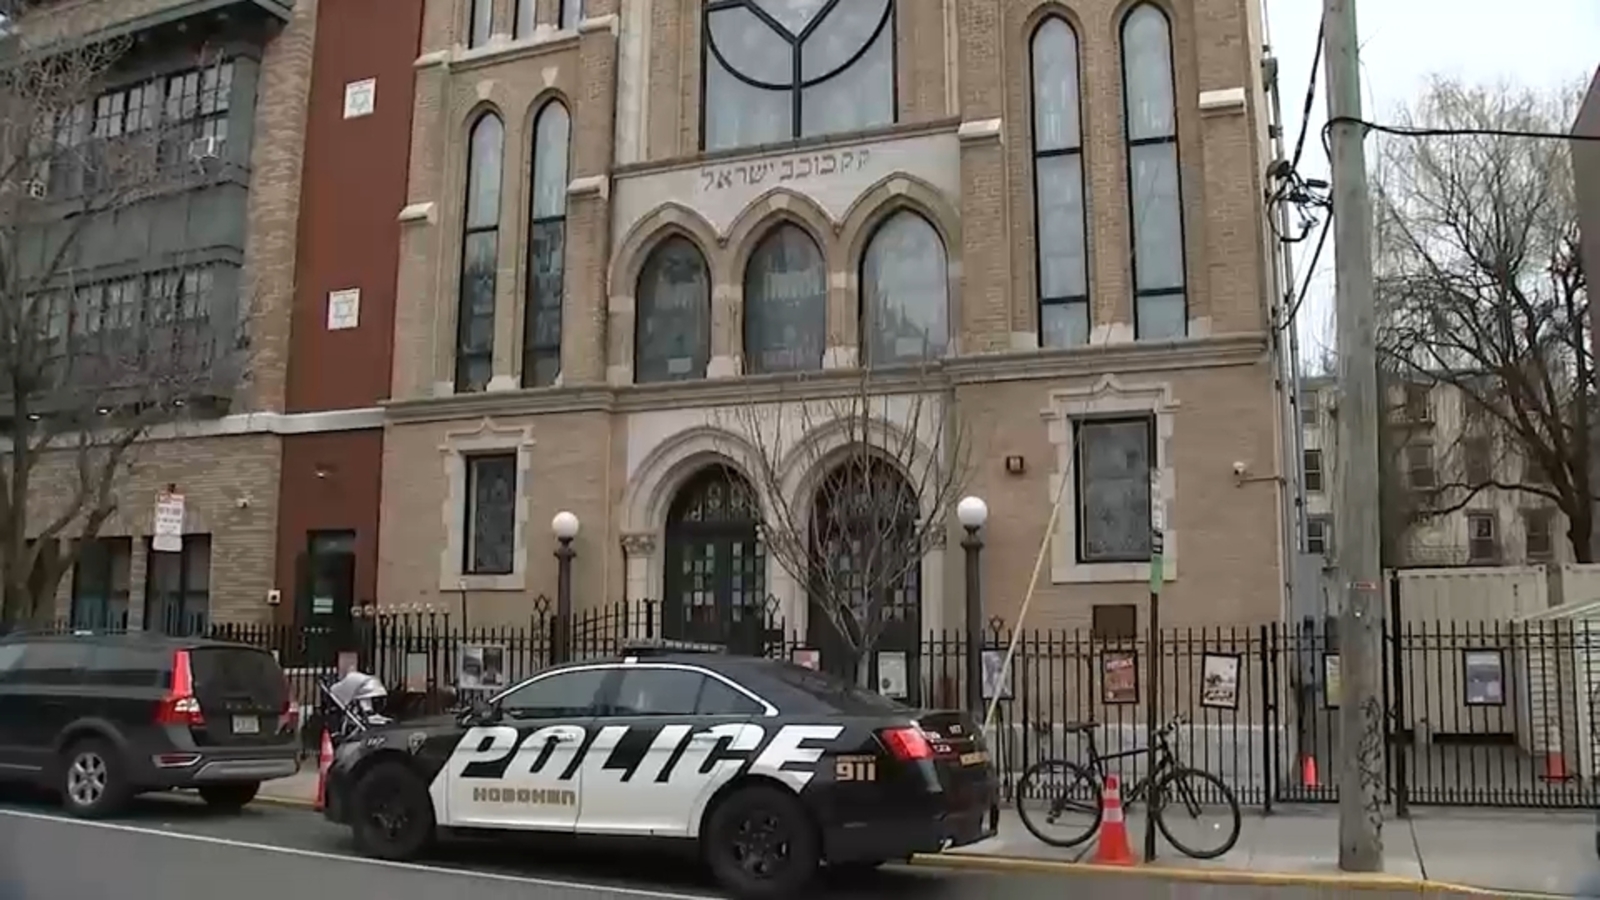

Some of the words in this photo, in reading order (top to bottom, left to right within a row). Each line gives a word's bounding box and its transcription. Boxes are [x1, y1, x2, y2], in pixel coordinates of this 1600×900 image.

[447, 724, 845, 794] POLICE
[836, 762, 876, 781] 911
[473, 787, 576, 806] HOBOKEN
